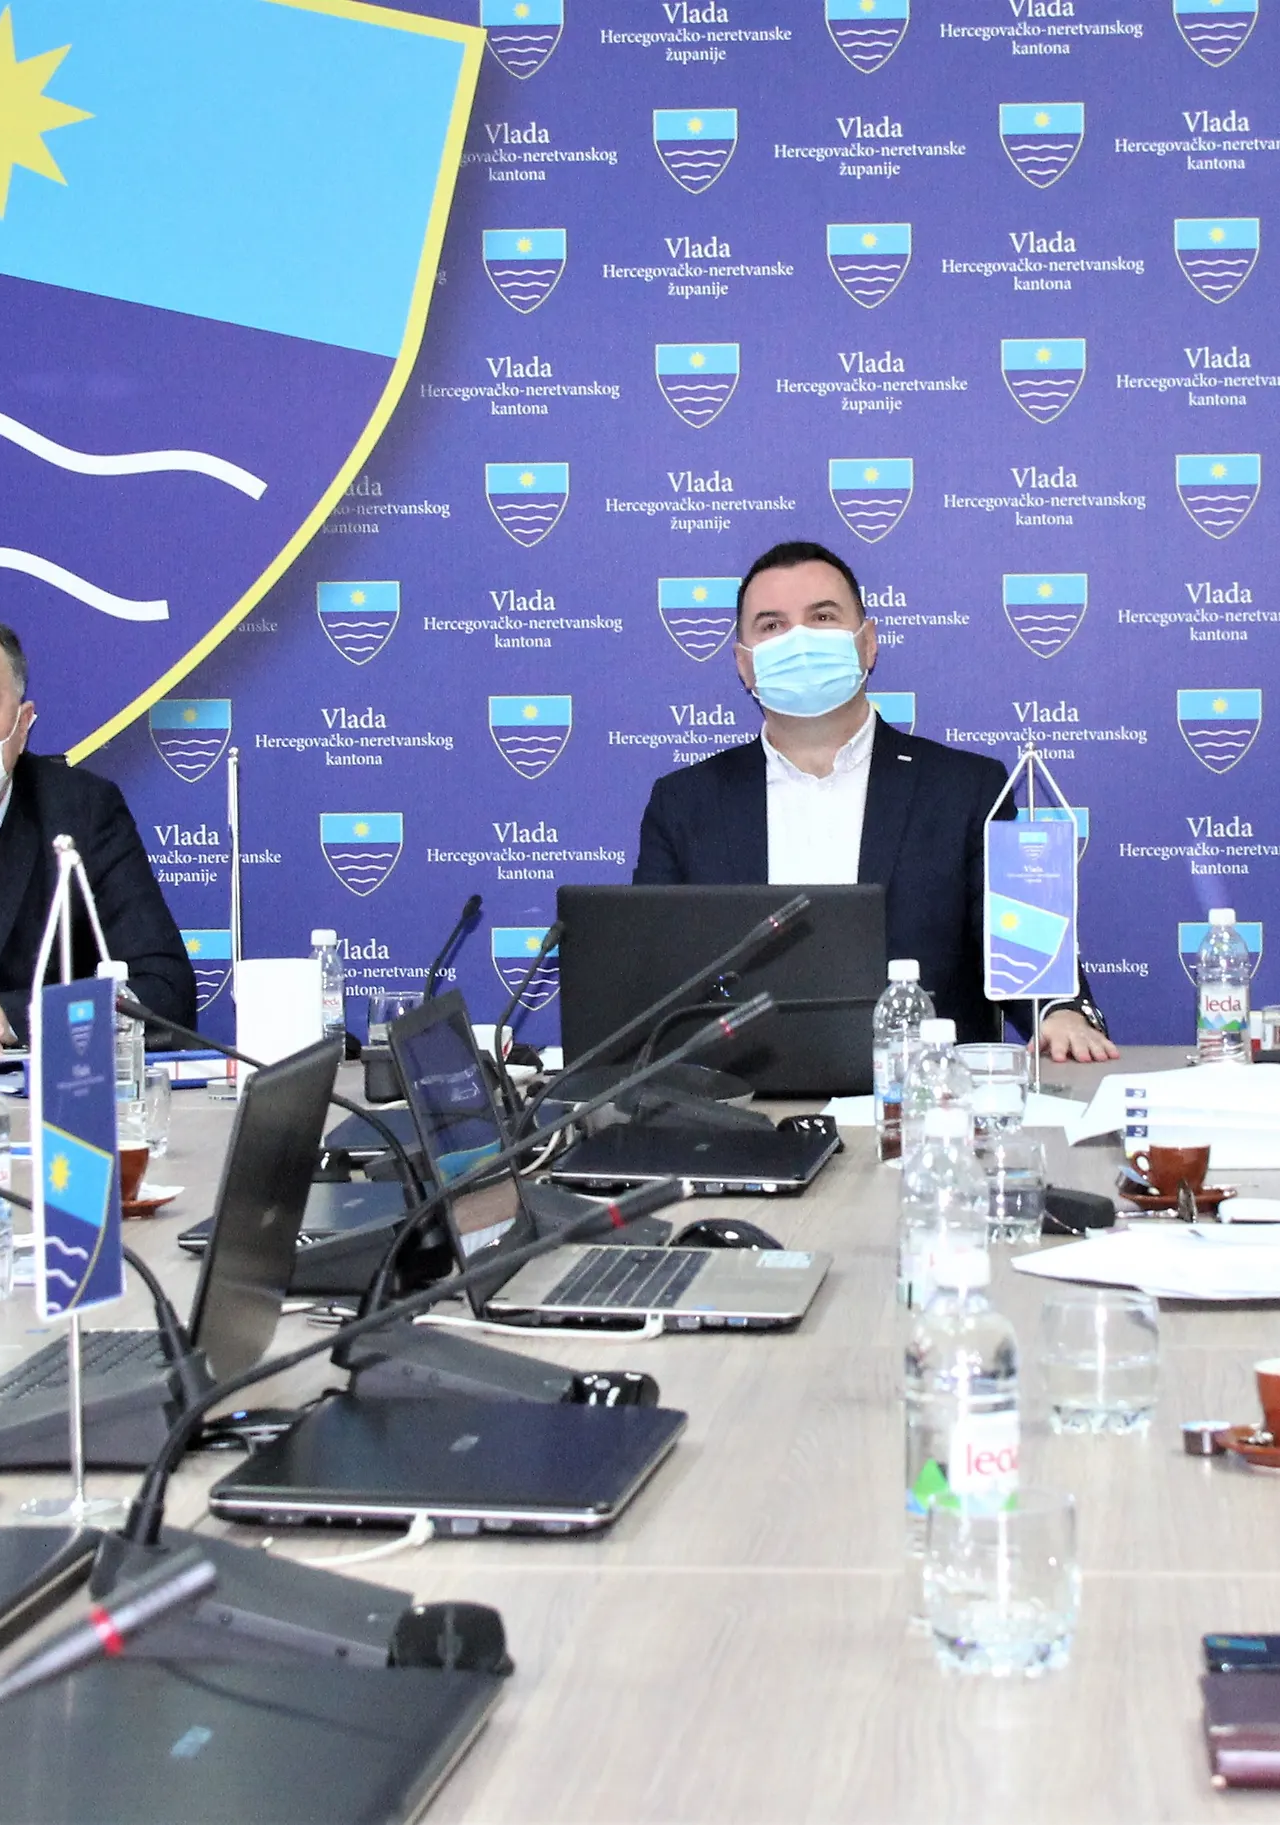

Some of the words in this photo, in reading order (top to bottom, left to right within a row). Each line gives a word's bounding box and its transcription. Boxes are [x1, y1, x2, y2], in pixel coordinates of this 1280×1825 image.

[661, 0, 730, 25] Vlada
[1008, 0, 1076, 18] Vlada
[600, 25, 793, 48] Hercegovačko-neretvanske
[939, 19, 1144, 42] Hercegovačko-neretvanskog
[665, 46, 727, 66] županije
[1011, 39, 1071, 56] kantona
[835, 115, 904, 139] Vlada
[1181, 109, 1251, 133] Vlada
[484, 120, 551, 145] Vlada
[460, 148, 619, 166] govačko-neretvanskog
[774, 140, 967, 163] Hercegovačko-neretvanske
[1186, 154, 1246, 171] kantona
[488, 167, 546, 182] kantona
[838, 161, 901, 180] županije
[663, 235, 732, 259] Vlada
[1008, 230, 1077, 254] Vlada
[602, 260, 794, 283] Hercegovačko-neretvanske
[941, 255, 1145, 278] Hercegovačko-neretvanskog
[667, 281, 729, 300] županije
[1013, 275, 1072, 291] kantona
[485, 355, 554, 379] Vlada
[837, 350, 906, 374] Vlada
[1183, 345, 1252, 369] Vlada
[420, 380, 621, 402] Hercegovačko-neretvanskog
[776, 375, 968, 397] Hercegovačko-neretvanske
[490, 400, 549, 416] kantona
[841, 396, 903, 415] županije
[1188, 391, 1247, 407] kantona
[666, 469, 734, 493] Vlada
[1009, 465, 1079, 489] Vlada
[605, 495, 797, 517] Hercegovačko-neretvanske
[943, 491, 1147, 512] Hercegovačko-neretvanskog
[670, 516, 732, 534] županije
[1015, 511, 1074, 526] kantona
[488, 588, 557, 612] Vlada
[859, 585, 908, 608] lada
[1184, 581, 1253, 604] Vlada
[423, 614, 624, 635] Hercegovačko-neretvanskog
[1189, 626, 1249, 642] kantona
[494, 633, 552, 649] kantona
[320, 706, 388, 729] Vlada
[669, 703, 737, 726] Vlada
[1011, 700, 1081, 723] Vlada
[255, 731, 454, 753] Hercegovačko-neretvanskog
[608, 730, 758, 749] Hercegovačko-neretv
[945, 725, 1148, 746] Hercegovačko-neretvanskog
[325, 750, 383, 766] kantona
[1016, 744, 1075, 759] kntona
[153, 824, 220, 846] Vlada
[491, 820, 559, 844] Vlada
[1185, 815, 1255, 838] Vlada
[426, 846, 626, 867] Hercegovačko-neretvanskog
[1190, 859, 1250, 876] kantona
[158, 869, 218, 887] županije
[497, 865, 555, 880] kantona
[345, 983, 385, 997] ntona
[1205, 994, 1242, 1012] leda
